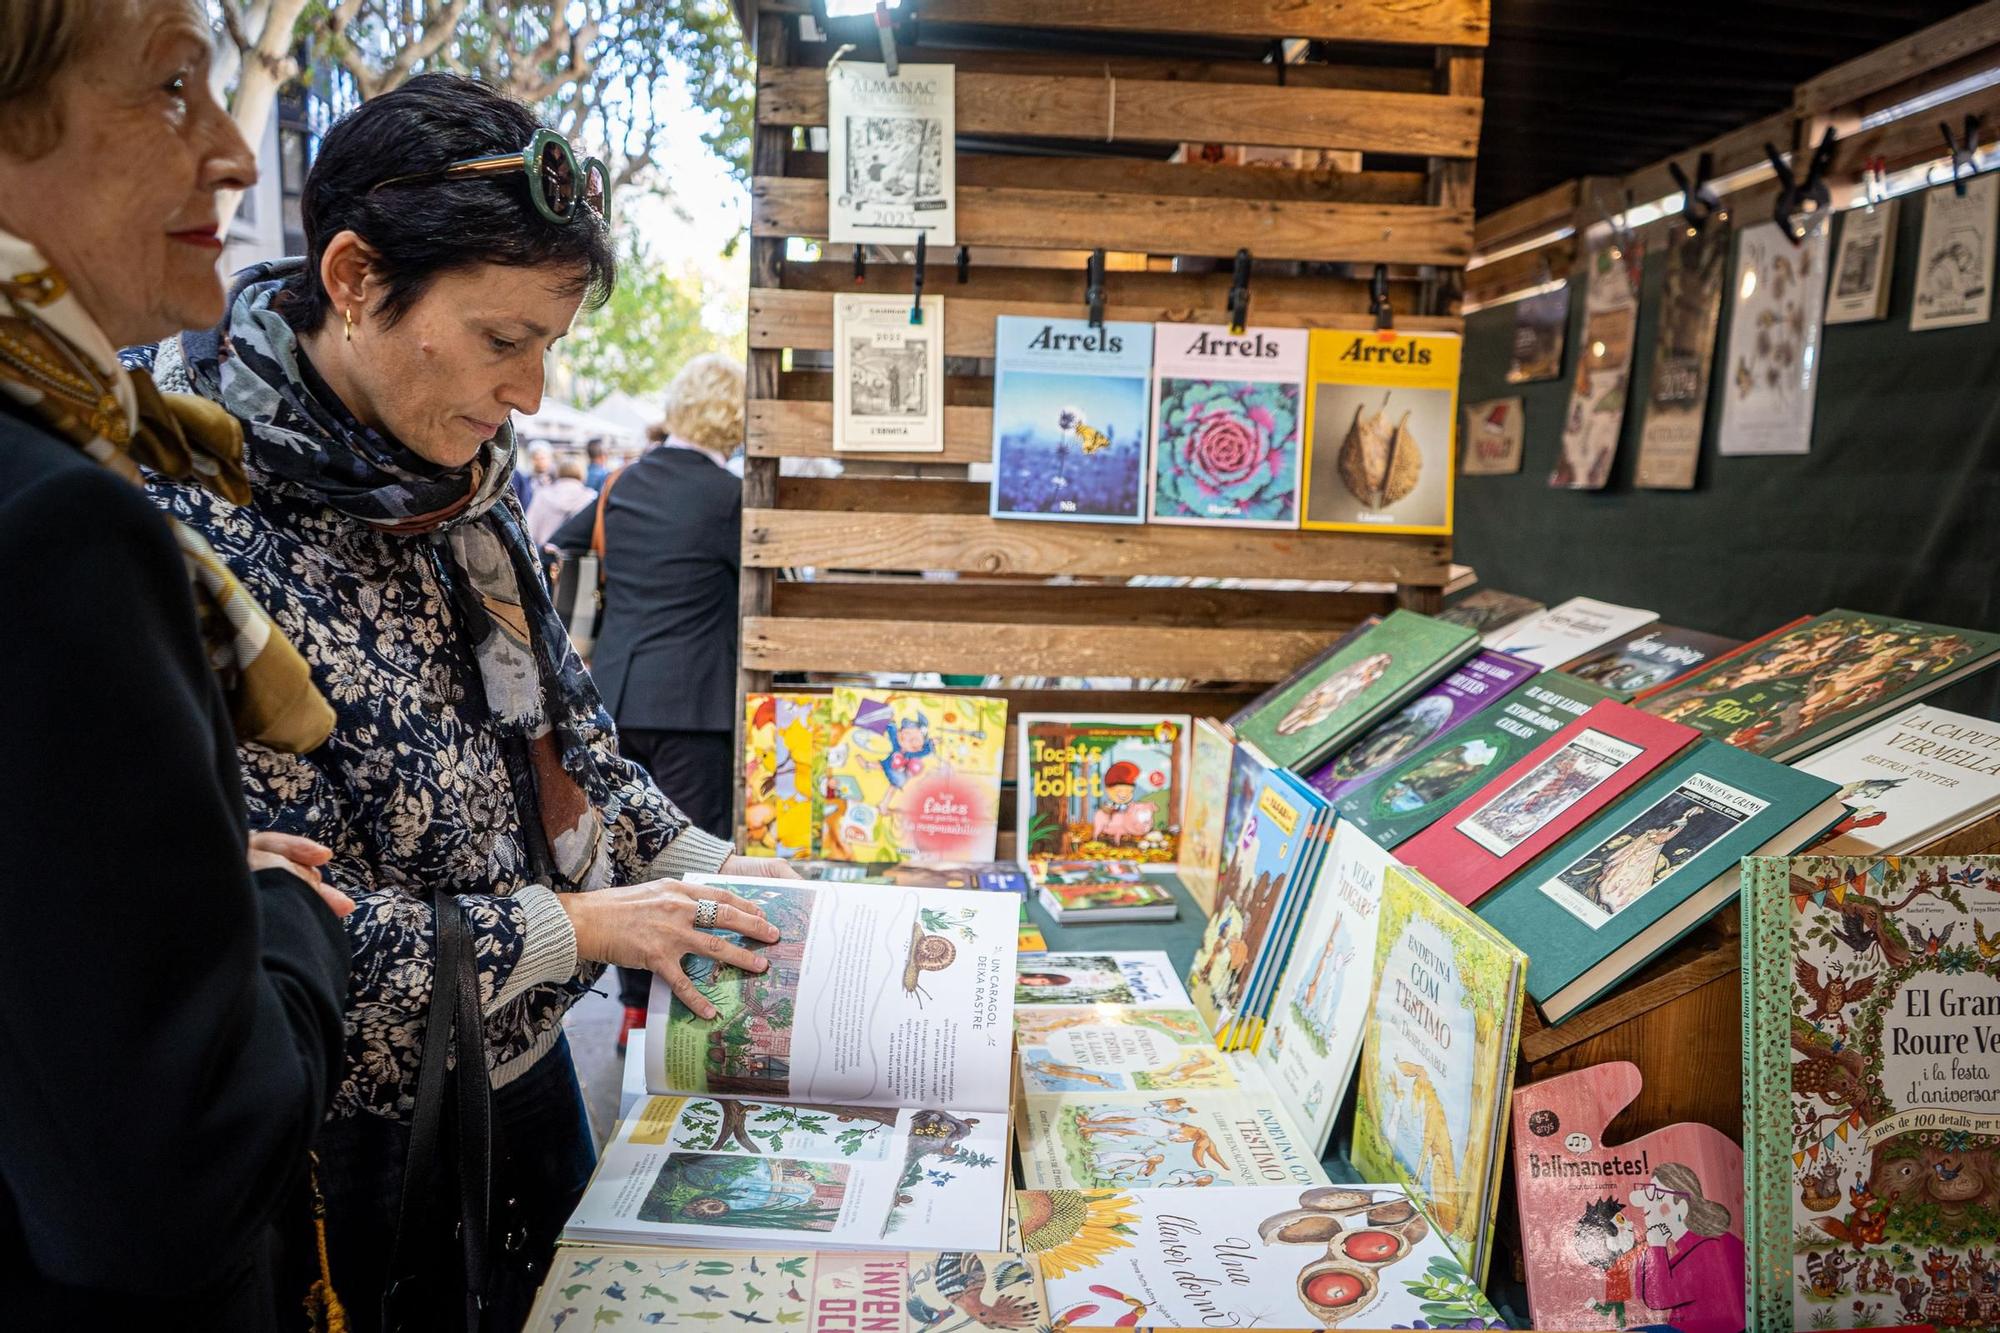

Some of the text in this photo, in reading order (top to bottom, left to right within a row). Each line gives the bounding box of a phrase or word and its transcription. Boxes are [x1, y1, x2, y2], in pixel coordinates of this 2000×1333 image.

[851, 80, 937, 94] ALMANAC
[873, 210, 915, 226] 2023
[1028, 325, 1124, 355] Arrels
[1186, 332, 1280, 361] Arrels
[1340, 336, 1432, 367] Arrels
[1902, 714, 2000, 750] LA CAPUT
[1033, 739, 1104, 763] Tocats
[1886, 732, 2000, 776] VERMELLA
[1033, 769, 1104, 798] bolet
[1862, 754, 1960, 788] BEATRIX POTTER
[1408, 934, 1450, 983] ENDEVINA
[972, 956, 987, 1030] DEIXA RASTRE
[986, 959, 1000, 1028] UN CARAGOL
[1411, 962, 1440, 1006] COM
[1395, 978, 1451, 1050] T'ESTIMO
[1906, 988, 2000, 1017] El Gran
[1068, 1032, 1083, 1042] DE
[1122, 1039, 1137, 1056] COM
[1135, 1030, 1161, 1065] ENDEVINA
[1892, 1027, 1968, 1056] Roure
[1744, 1050, 1750, 1061] El
[1924, 1057, 1990, 1081] i la festa
[1536, 1122, 1555, 1134] anys
[1898, 1116, 1910, 1129] de
[1914, 1114, 1936, 1127] 100
[1938, 1112, 1972, 1128] detalls
[1974, 1117, 1992, 1131] per
[1224, 1134, 1258, 1186] TRENCACLOSQUE
[1235, 1120, 1286, 1181] T'ESTIMO
[1257, 1109, 1301, 1160] ENDEVINA
[1290, 1165, 1314, 1186] CO
[1530, 1150, 1650, 1178] Ballmanetes!
[1156, 1215, 1202, 1268] llavor
[1213, 1238, 1258, 1286] Una
